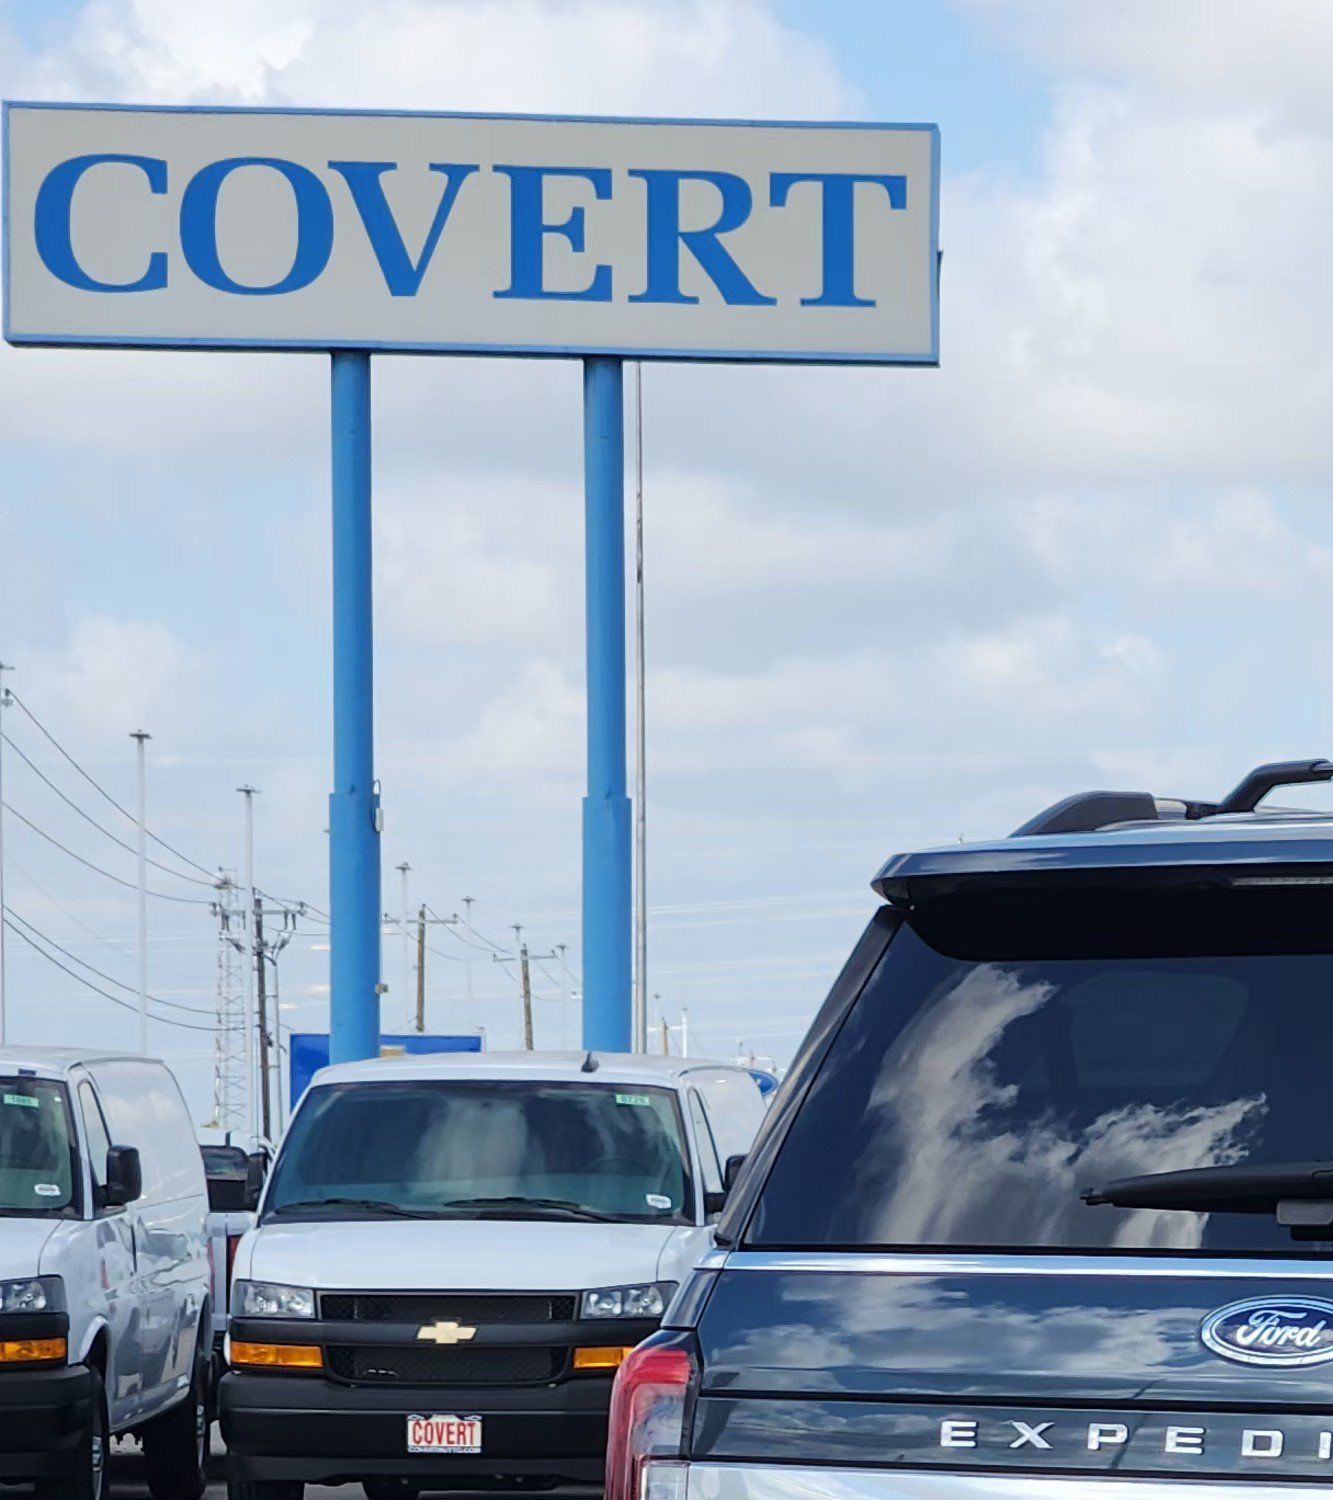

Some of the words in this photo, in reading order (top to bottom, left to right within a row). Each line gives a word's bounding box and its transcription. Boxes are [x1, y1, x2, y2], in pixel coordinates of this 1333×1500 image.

[34, 153, 907, 308] COVERT
[1236, 1310, 1327, 1347] Ford
[412, 1421, 475, 1445] COVERT
